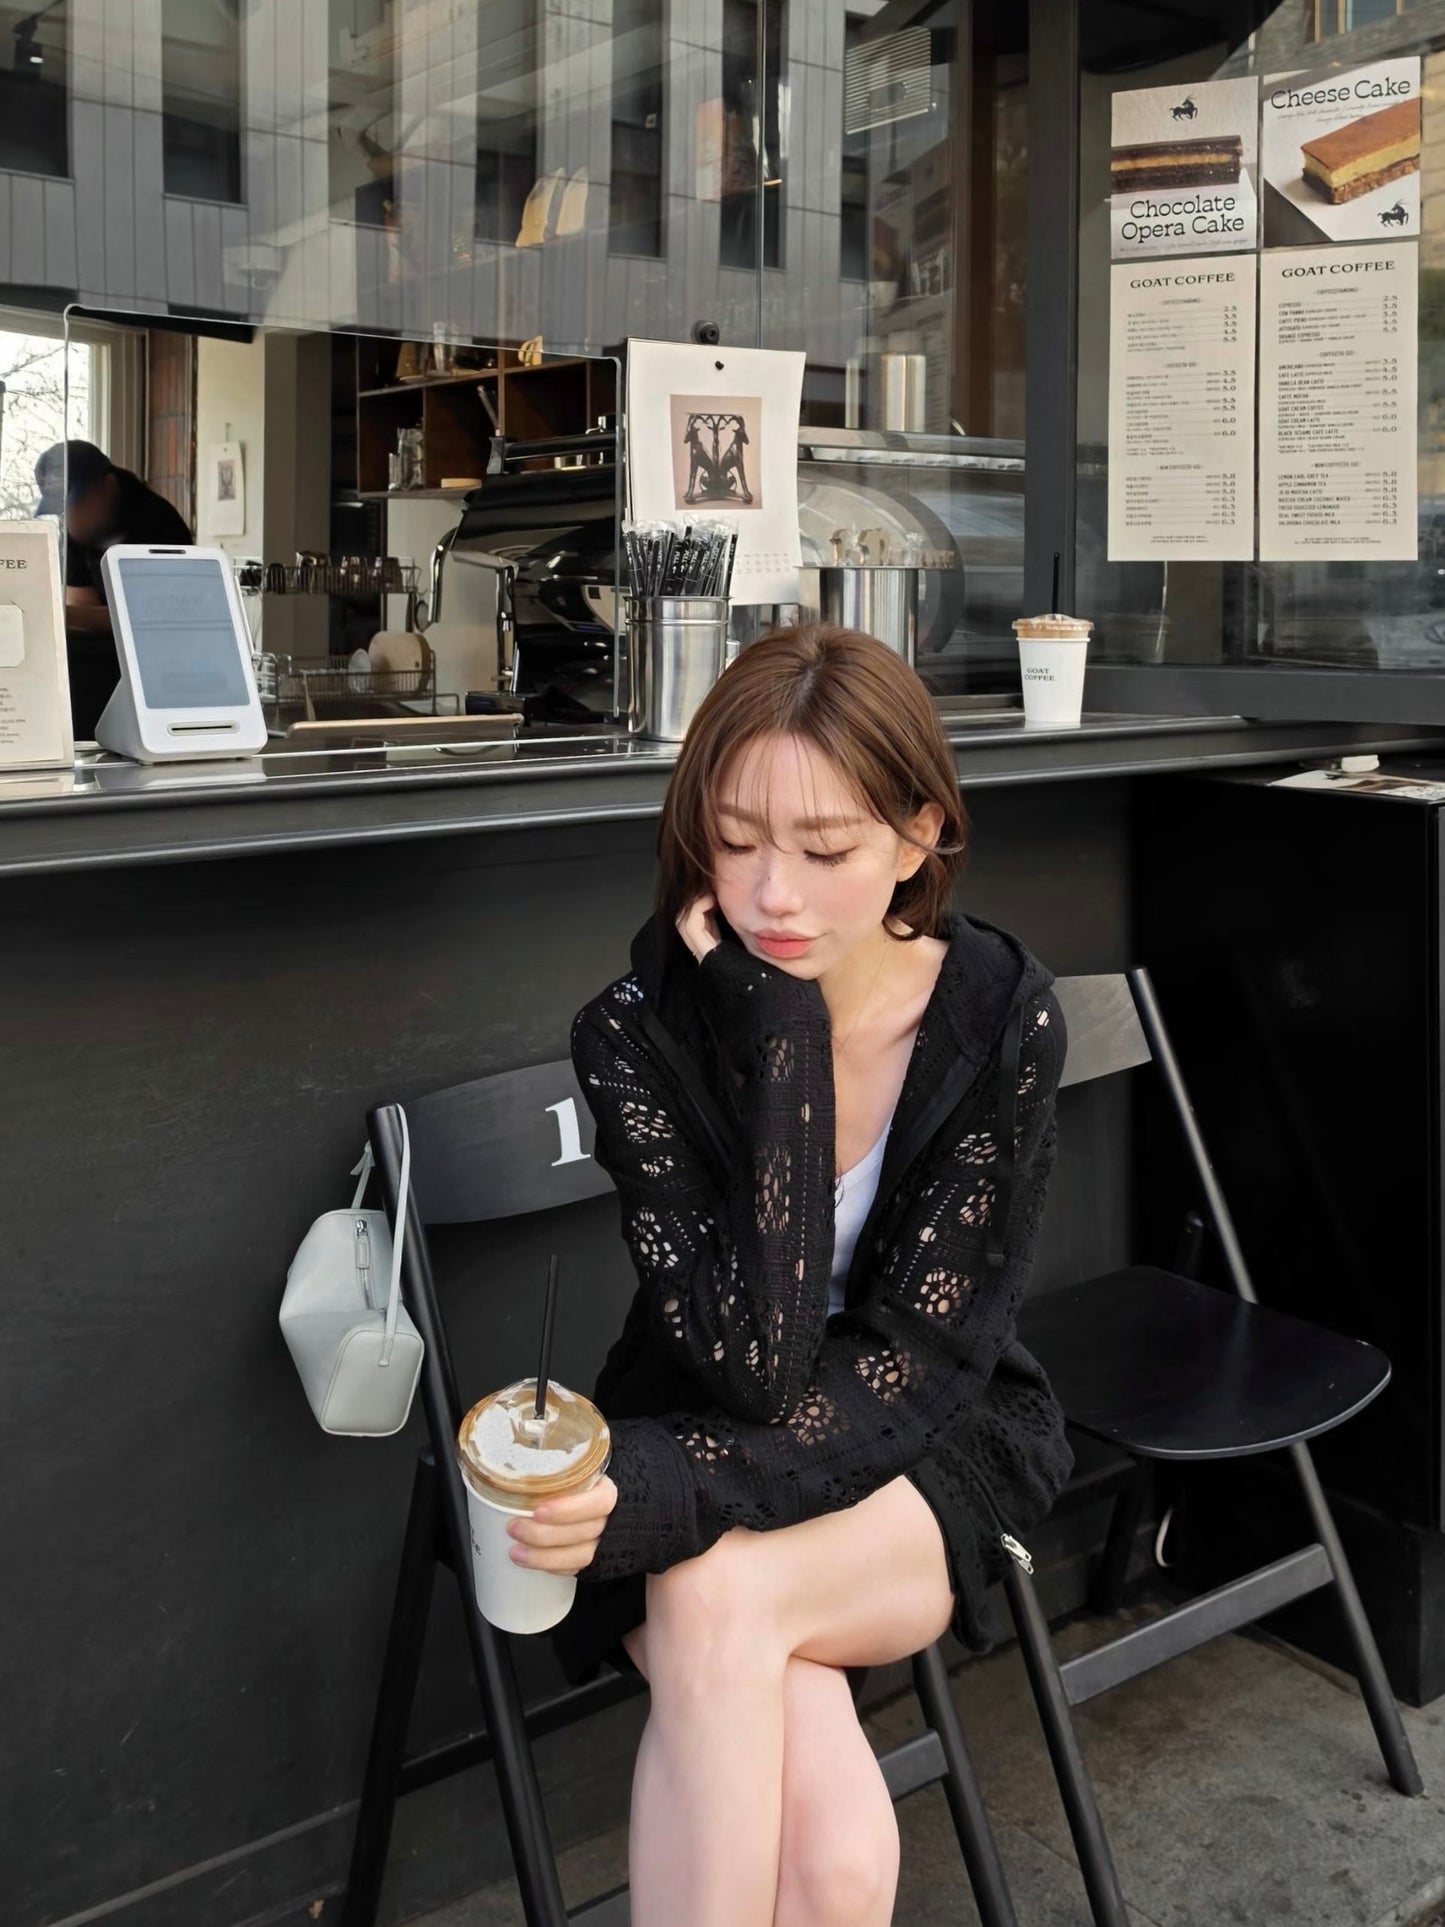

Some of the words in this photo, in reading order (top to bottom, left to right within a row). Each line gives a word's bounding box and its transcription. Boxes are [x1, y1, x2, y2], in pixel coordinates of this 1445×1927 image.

[1270, 82, 1350, 109] Cheese
[1354, 76, 1411, 99] Cake
[1130, 194, 1236, 219] Chocolate
[1121, 221, 1186, 244] Opera
[1191, 213, 1245, 235] Cake
[1130, 277, 1172, 289] GOAT
[1174, 272, 1236, 286] COFFEE
[1282, 265, 1327, 278] GOAT
[1329, 260, 1395, 275] COFFEE
[545, 1097, 592, 1167] 1
